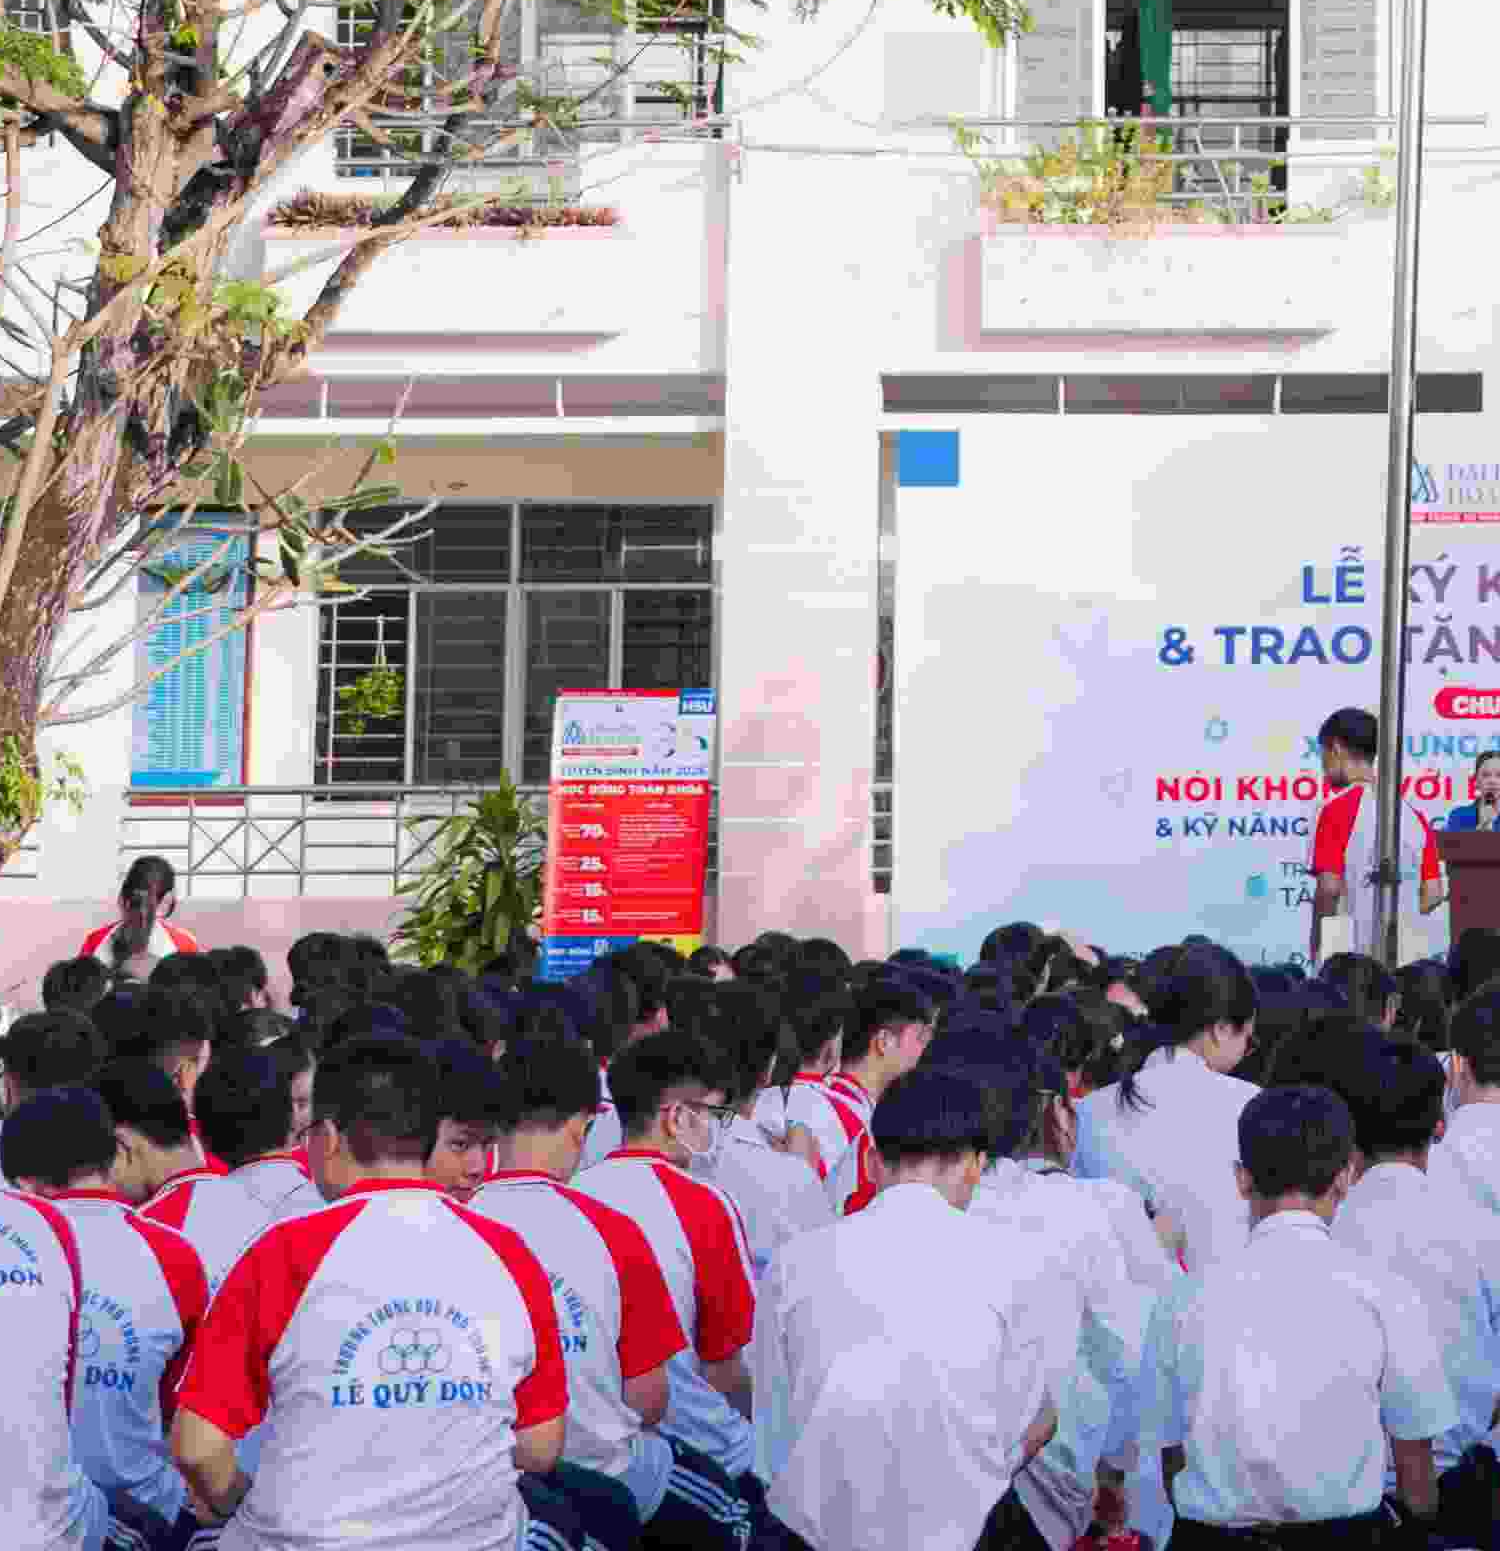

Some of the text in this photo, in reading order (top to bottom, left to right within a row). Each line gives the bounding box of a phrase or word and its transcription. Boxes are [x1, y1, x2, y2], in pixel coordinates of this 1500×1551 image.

[1302, 545, 1365, 603] LỄ
[1158, 625, 1195, 666] &
[1213, 625, 1373, 666] TRAO
[1155, 816, 1173, 837] &
